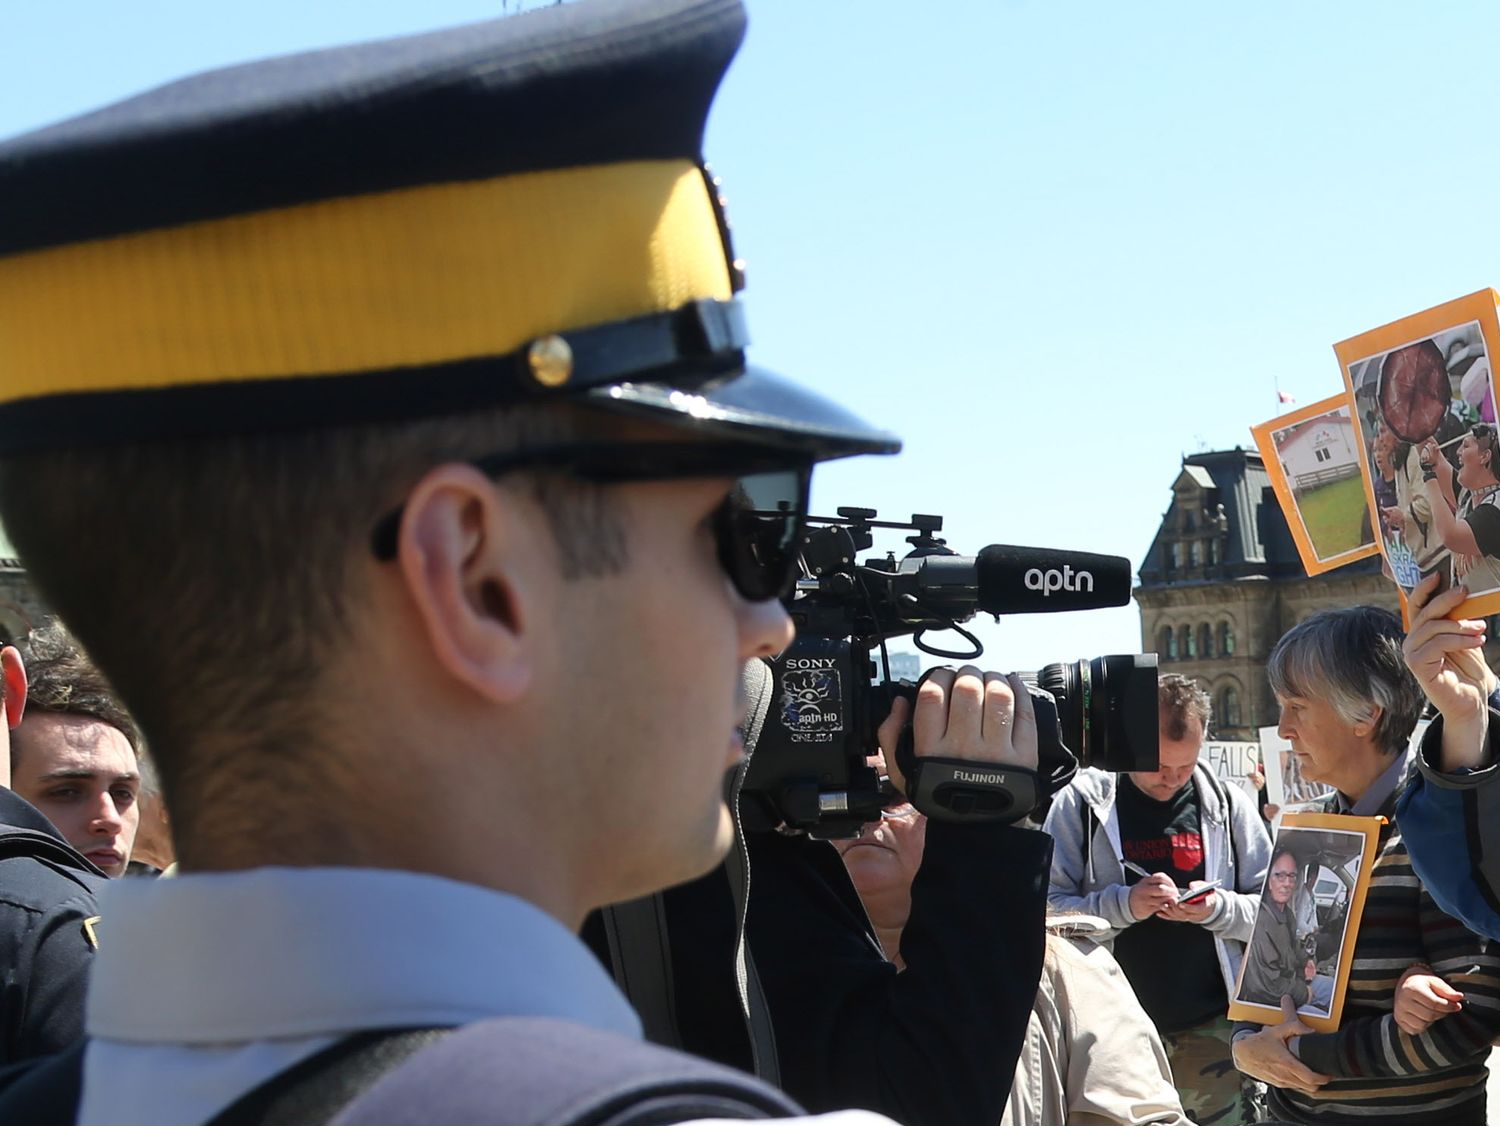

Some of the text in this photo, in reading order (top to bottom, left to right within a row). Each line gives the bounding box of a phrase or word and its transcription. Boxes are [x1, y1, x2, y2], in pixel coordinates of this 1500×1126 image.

[1023, 565, 1094, 597] aptn
[786, 658, 836, 669] SONY
[823, 712, 838, 722] HD
[1208, 745, 1257, 778] FALLS
[953, 770, 1005, 784] FUJINON
